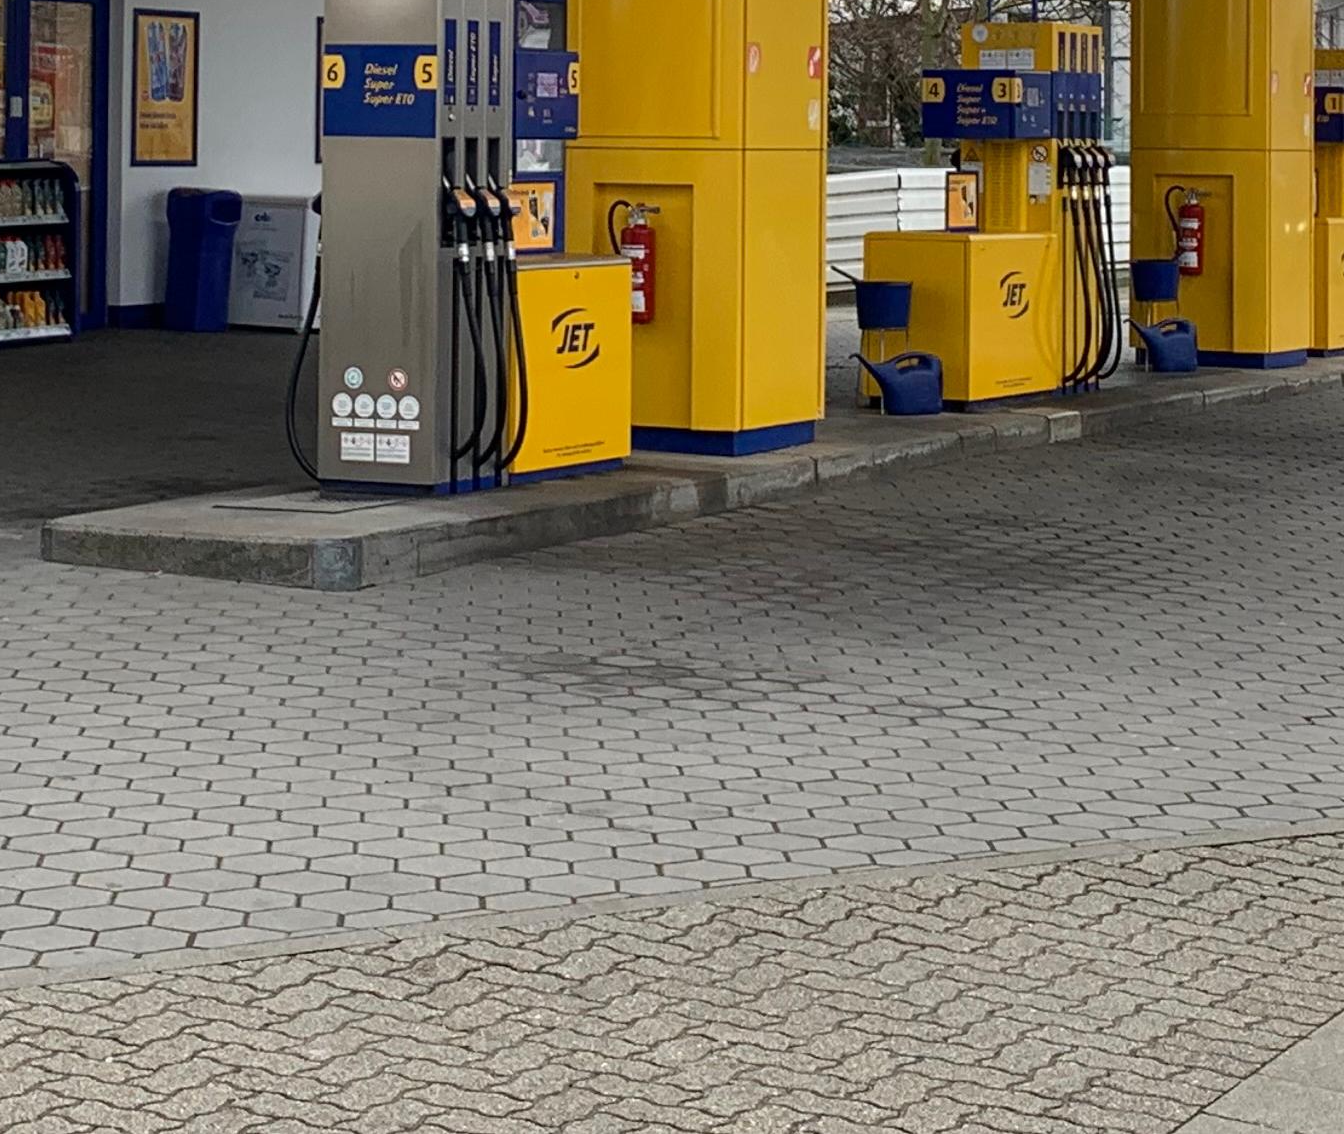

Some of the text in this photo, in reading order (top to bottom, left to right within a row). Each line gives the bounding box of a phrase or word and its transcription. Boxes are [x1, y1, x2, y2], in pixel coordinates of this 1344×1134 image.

[327, 63, 433, 83] 6 5
[364, 63, 398, 75] Diesel
[363, 77, 395, 92] Super
[570, 69, 577, 88] 5
[928, 82, 1007, 98] 4 3
[363, 92, 415, 107] Super E10
[1002, 283, 1027, 307] JET
[556, 323, 595, 354] JET
